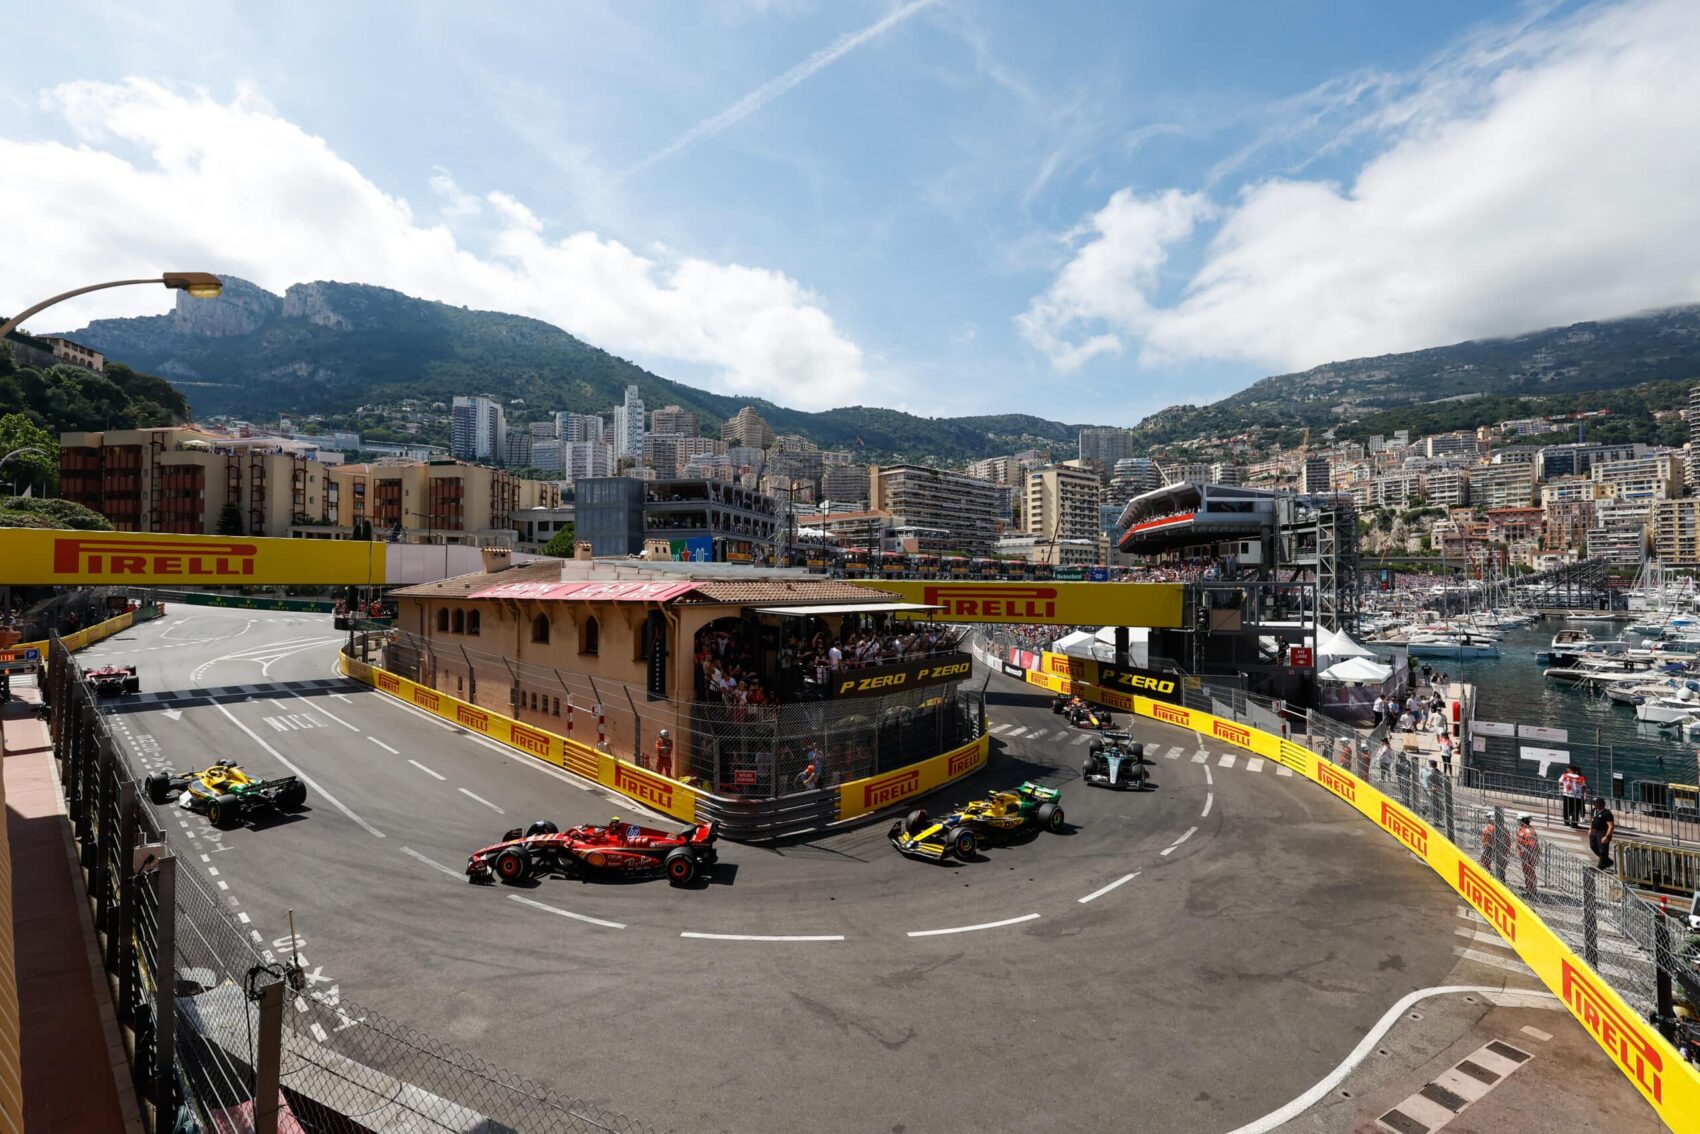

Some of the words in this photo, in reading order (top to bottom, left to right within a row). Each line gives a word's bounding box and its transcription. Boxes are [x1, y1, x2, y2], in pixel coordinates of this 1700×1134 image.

[54, 538, 258, 575] PIRELLI
[924, 586, 1058, 618] PIRELLI
[918, 669, 928, 680] P
[931, 662, 970, 677] ZERO
[1051, 656, 1085, 678] PIRELLI
[378, 673, 400, 694] PIRELLI
[840, 681, 855, 693] P
[857, 673, 906, 690] ZERO
[1102, 669, 1115, 679] P
[1118, 672, 1174, 694] ZERO
[414, 687, 439, 711] PIRELLI
[1101, 690, 1132, 710] PIRELLI
[262, 713, 329, 731] NICE
[457, 704, 488, 732] PIRELLI
[1153, 704, 1190, 726] PIRELLI
[511, 725, 550, 757] PIRELLI
[1213, 720, 1250, 747] PIRELLI
[948, 744, 980, 777] PIRELLI
[615, 764, 673, 809] PIRELLI
[864, 770, 919, 808] PIRELLI
[1318, 761, 1355, 802] PIRELLI
[630, 825, 641, 837] hp
[1381, 801, 1428, 857] PIRELLI
[1459, 860, 1516, 942] PIRELLI
[272, 934, 366, 1032] TAXIS
[1562, 957, 1663, 1105] PIRELLI
